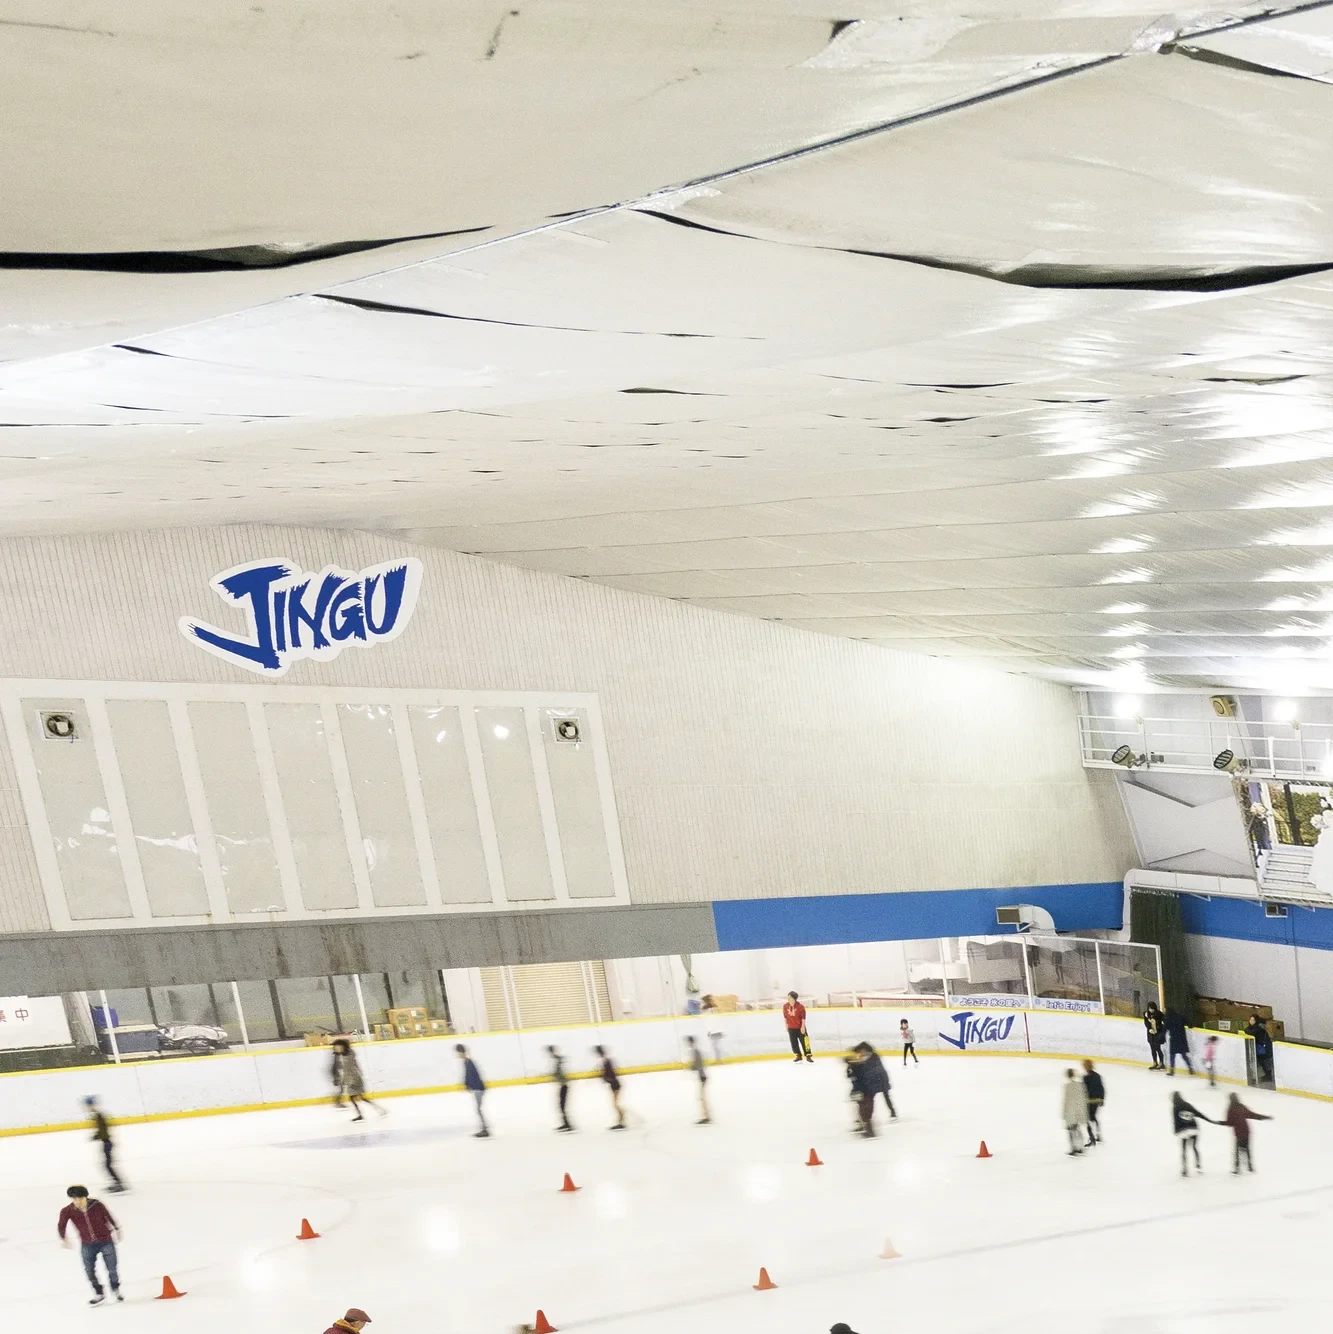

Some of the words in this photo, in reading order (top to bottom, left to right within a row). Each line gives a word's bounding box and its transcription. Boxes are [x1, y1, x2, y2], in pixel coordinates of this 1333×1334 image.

[188, 564, 408, 670] JINGU
[1064, 1001, 1091, 1012] Enjoy!
[938, 1011, 1015, 1050] JINGU
